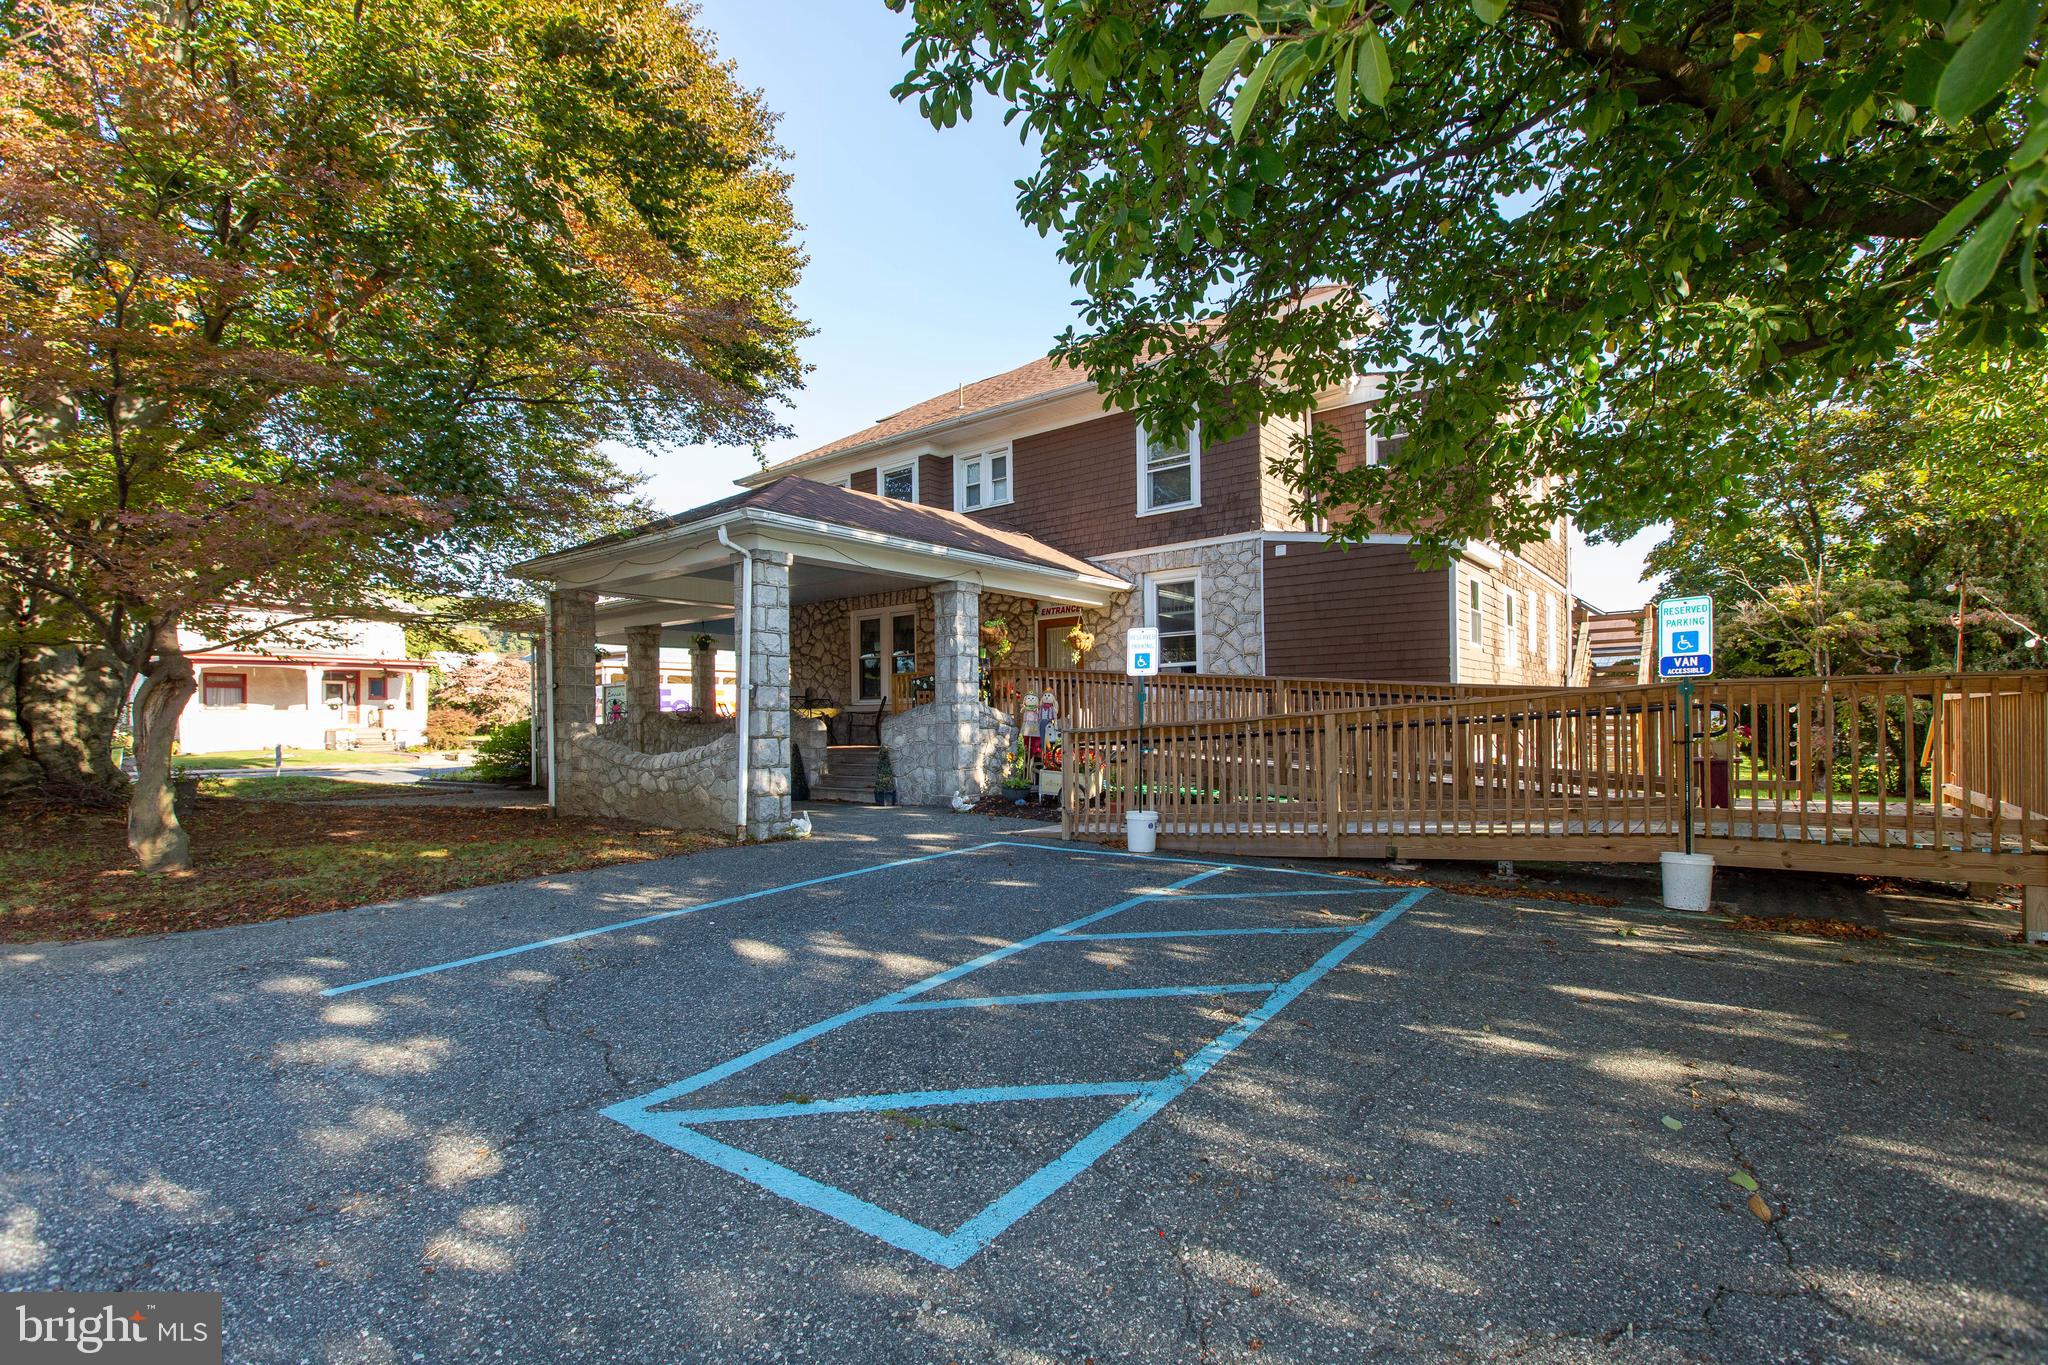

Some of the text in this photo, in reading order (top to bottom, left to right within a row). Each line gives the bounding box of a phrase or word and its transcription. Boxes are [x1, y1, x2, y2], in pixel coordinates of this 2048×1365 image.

[1663, 605, 1708, 615] RESERVED
[1666, 617, 1704, 627] PARKING
[1674, 657, 1698, 667] VAN
[1667, 667, 1704, 675] ACCESSIBLE
